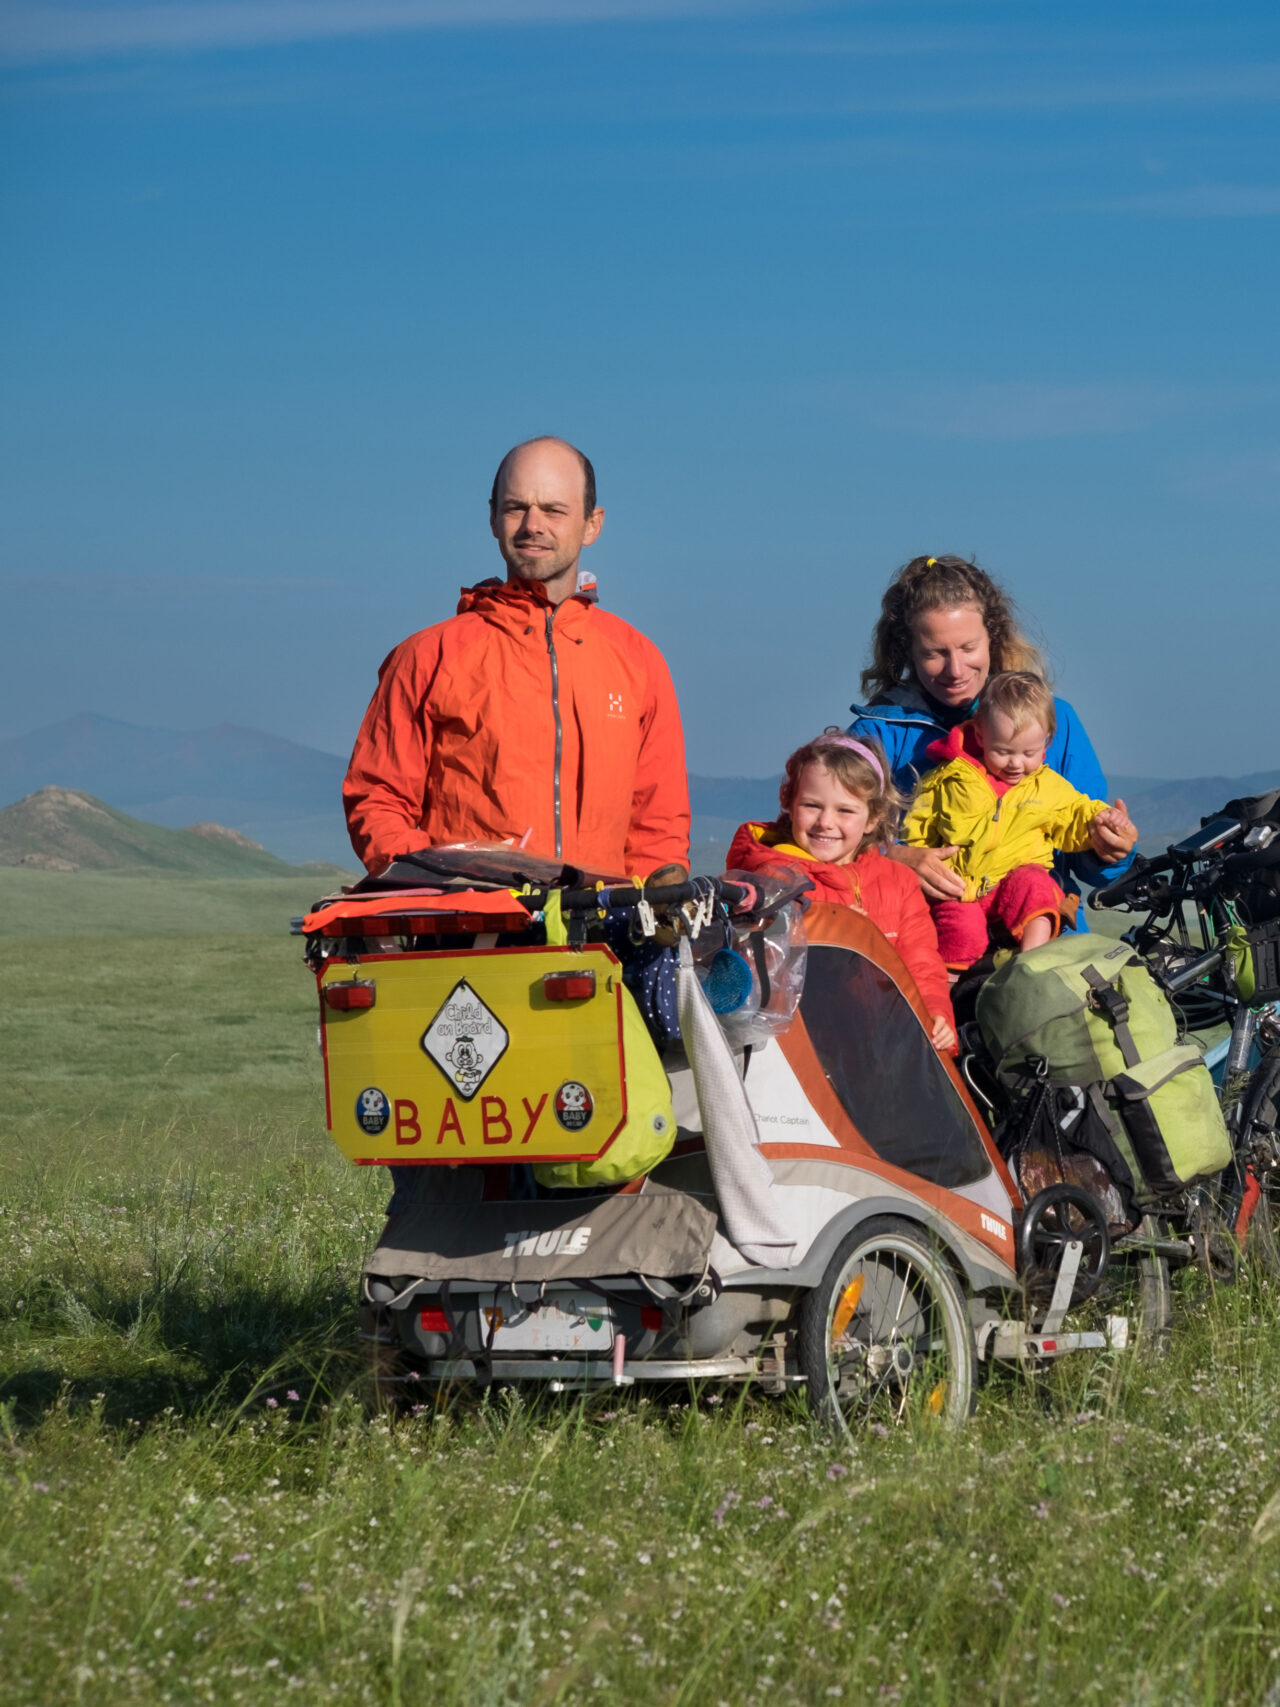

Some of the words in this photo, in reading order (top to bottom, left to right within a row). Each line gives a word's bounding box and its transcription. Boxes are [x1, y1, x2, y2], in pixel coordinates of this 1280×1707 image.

[445, 1003, 482, 1021] Child
[437, 1024, 453, 1036] on
[455, 1017, 492, 1036] Board
[363, 1116, 384, 1126] BABY
[394, 1093, 549, 1146] BABY
[562, 1111, 587, 1121] BABY
[980, 1212, 1007, 1241] THULE
[502, 1227, 592, 1258] THULE
